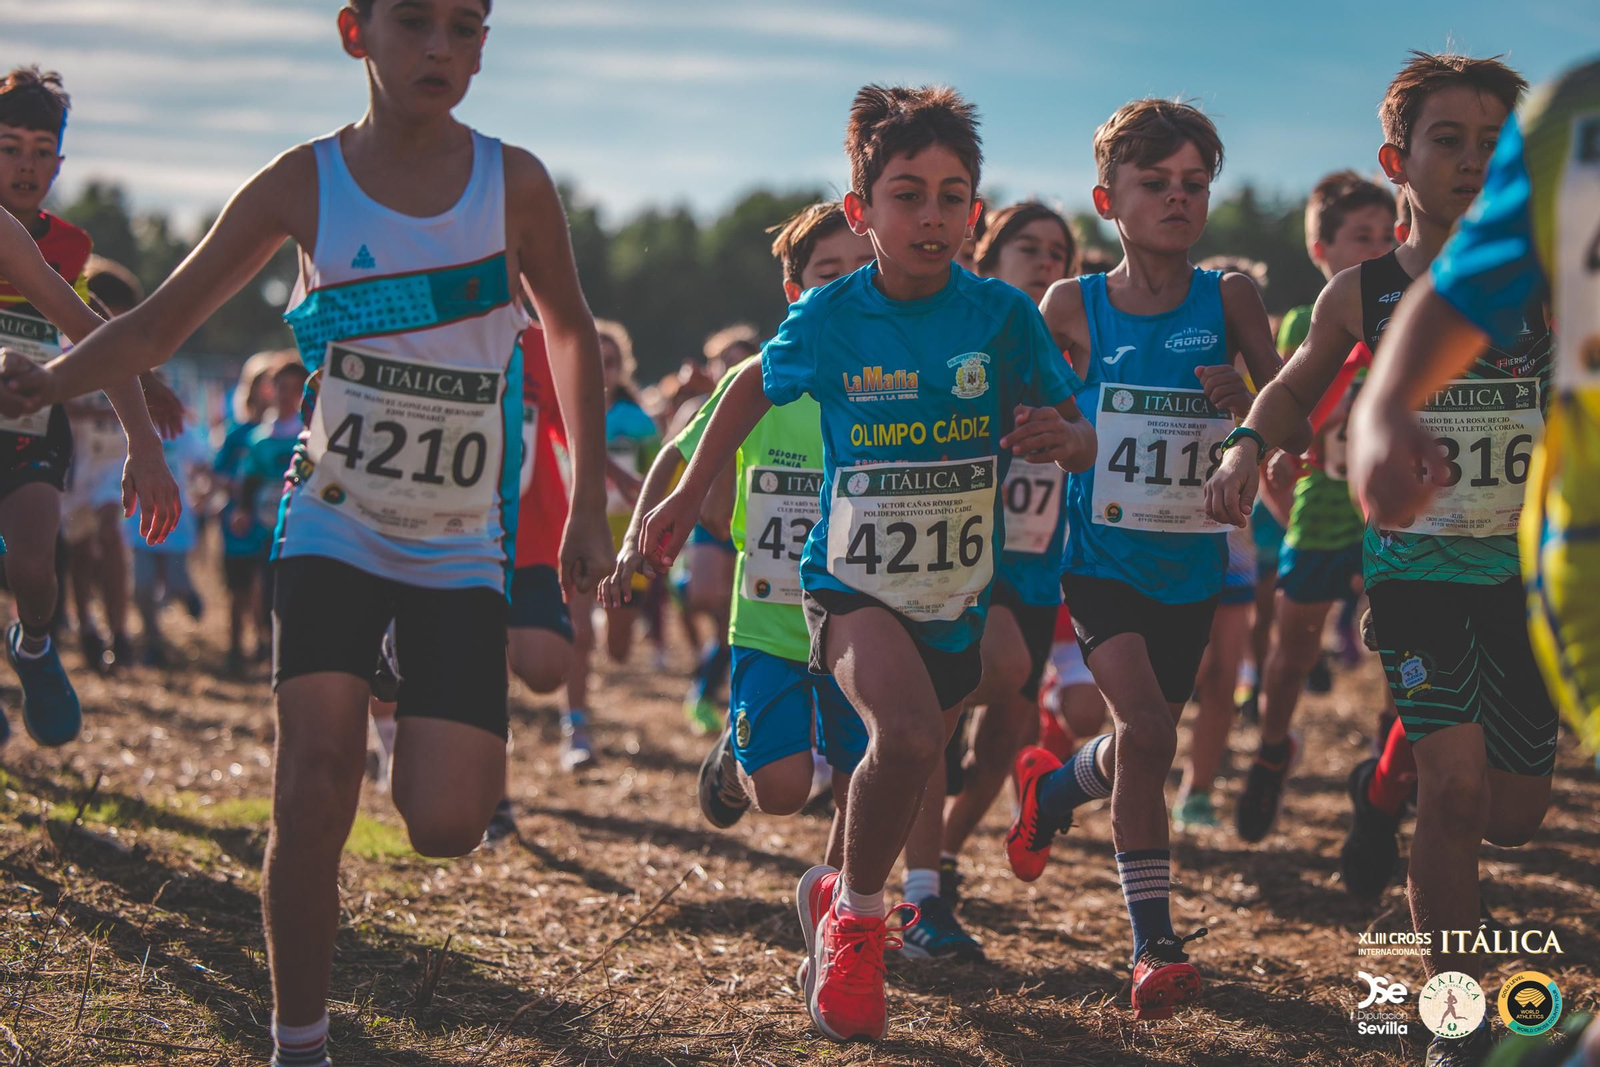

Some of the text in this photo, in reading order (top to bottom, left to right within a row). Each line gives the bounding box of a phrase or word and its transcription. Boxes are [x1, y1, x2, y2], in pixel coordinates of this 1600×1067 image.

[377, 366, 465, 396] ITÁLICA
[1144, 393, 1209, 413] ITÁLICA
[1425, 386, 1504, 406] ITÁLICA
[1420, 416, 1442, 424] DARÍO
[851, 414, 990, 447] OLIMPO CÁDIZ
[1152, 428, 1202, 436] INDEPENDIENTE
[327, 412, 488, 488] 4210
[768, 449, 808, 462] DEPORTE
[772, 458, 802, 468] MANIA
[1108, 438, 1223, 486] 4118
[880, 469, 960, 490] ITÁLICA
[906, 498, 931, 508] CAÑAS
[932, 498, 963, 506] ROMERO
[1008, 478, 1055, 516] 07
[864, 509, 924, 517] POLIDEPORTIVO
[954, 505, 972, 513] CADIZ
[758, 517, 815, 561] 43
[846, 515, 984, 574] 4216
